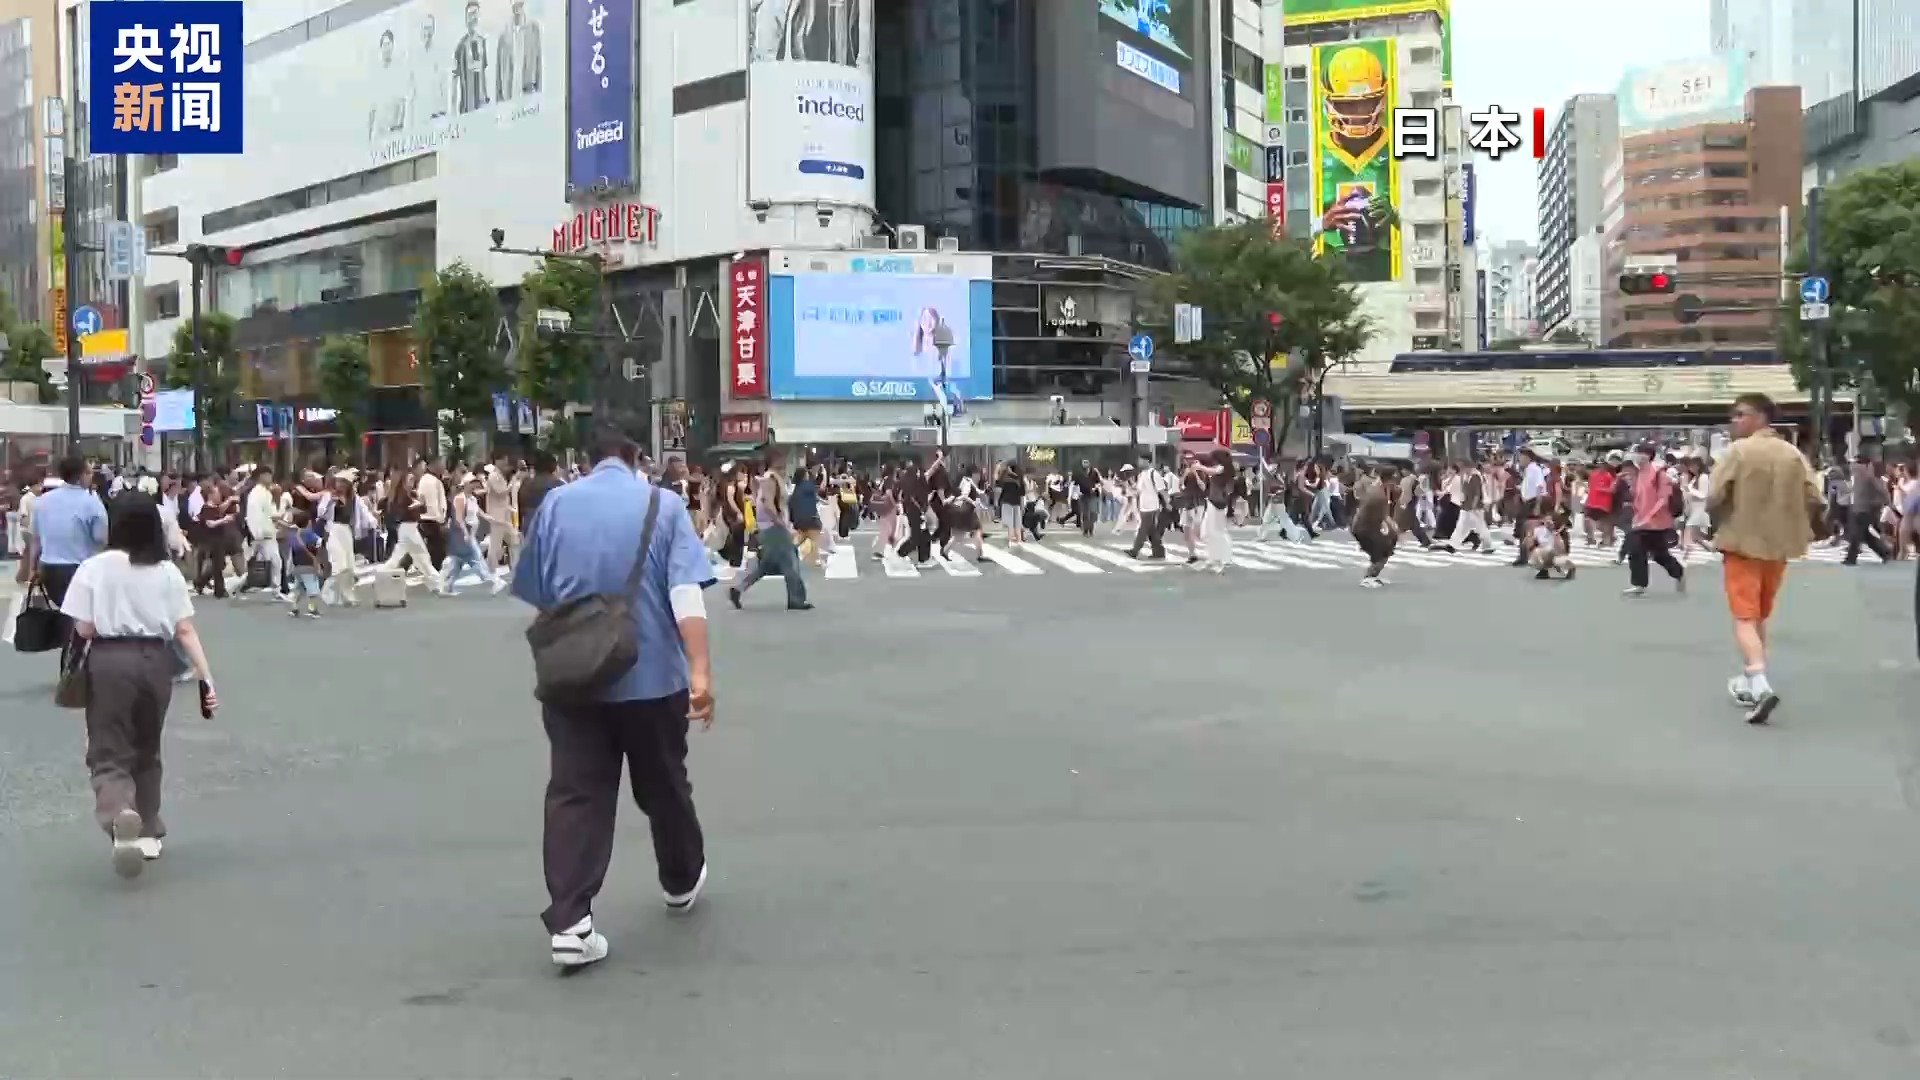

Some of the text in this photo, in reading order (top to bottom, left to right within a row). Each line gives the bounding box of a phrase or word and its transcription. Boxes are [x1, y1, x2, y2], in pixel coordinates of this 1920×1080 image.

[587, 0, 609, 88] せる。
[796, 95, 865, 123] indeed
[576, 121, 624, 150] indeed
[551, 202, 662, 252] MAGNET
